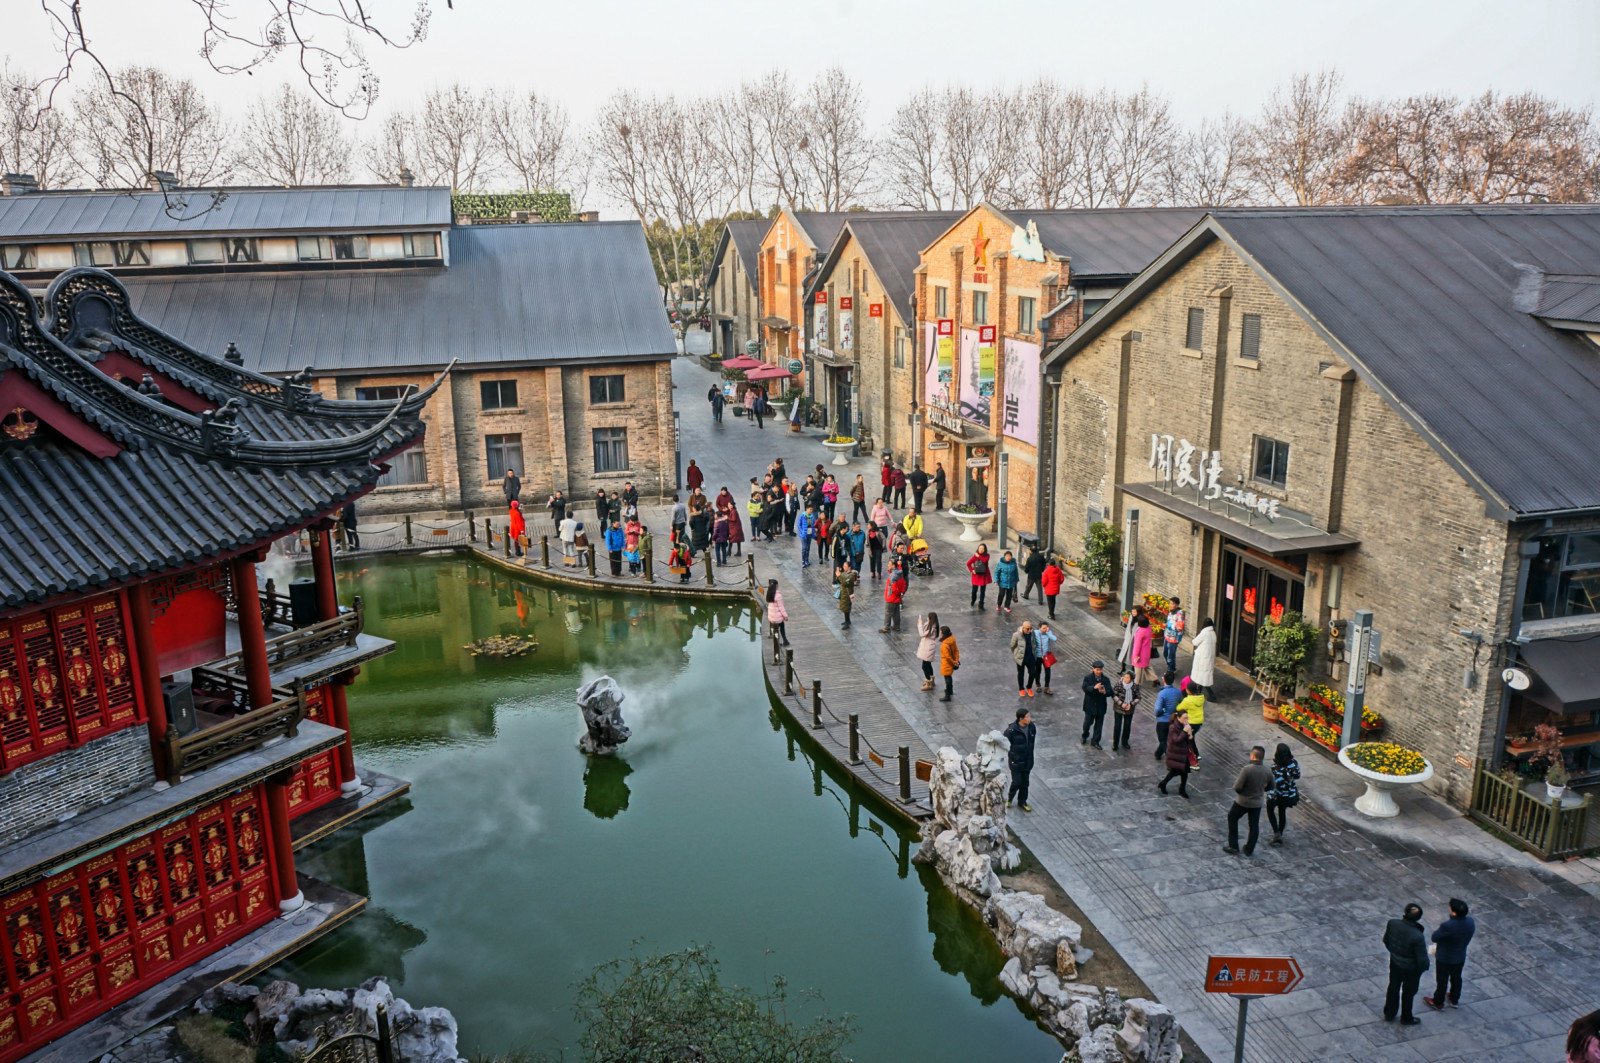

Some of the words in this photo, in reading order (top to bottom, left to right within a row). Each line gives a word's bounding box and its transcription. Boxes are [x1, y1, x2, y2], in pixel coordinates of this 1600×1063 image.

[927, 406, 963, 434] PAULANER
[1235, 968, 1289, 983] 民防工程
